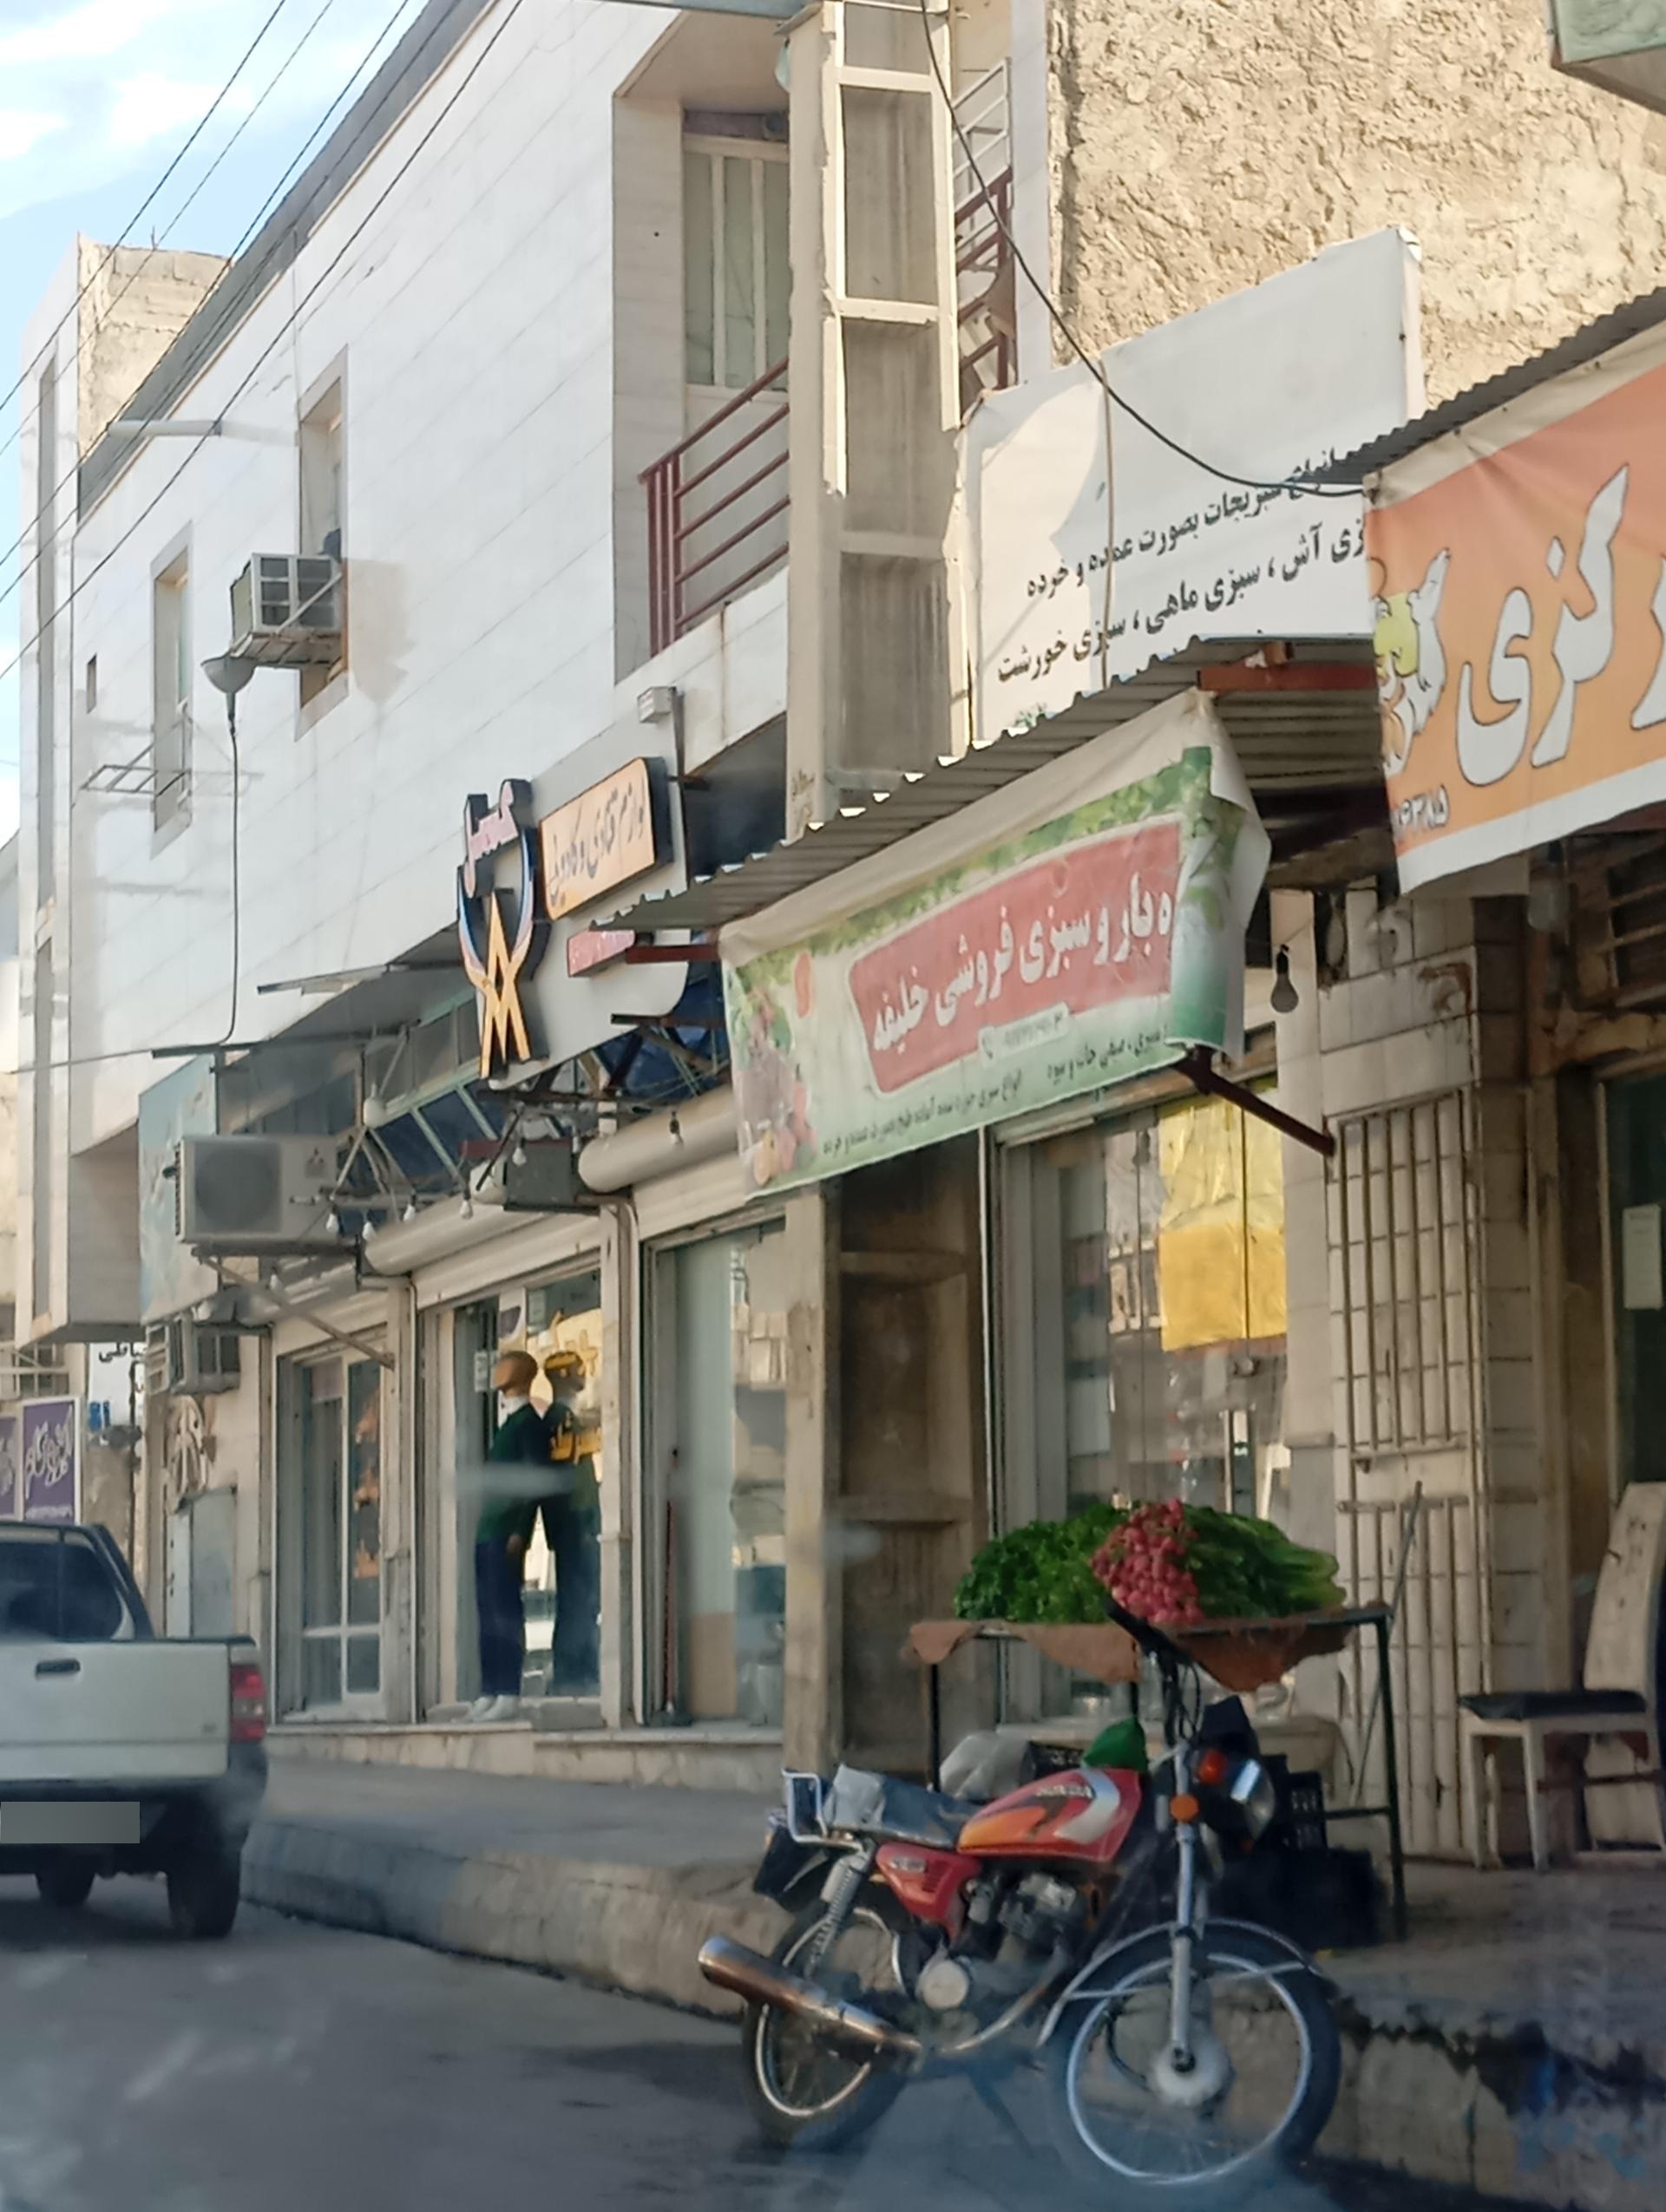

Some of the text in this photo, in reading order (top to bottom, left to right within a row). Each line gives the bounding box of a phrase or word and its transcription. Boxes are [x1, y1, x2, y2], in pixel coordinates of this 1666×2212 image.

[1089, 538, 1132, 571] عمده
[1139, 514, 1198, 555] بصورت
[1282, 521, 1322, 582] آش
[1332, 518, 1364, 563] زی
[1076, 562, 1084, 587] و
[1205, 566, 1260, 612] سبزی
[1146, 579, 1198, 634] ماهی
[998, 629, 1067, 683] خورشت
[1073, 618, 1126, 662] سبزی
[1019, 906, 1091, 985] سبزی
[1093, 906, 1110, 965] و
[935, 906, 1014, 1028] فروشی
[874, 965, 929, 1054] خلیفه
